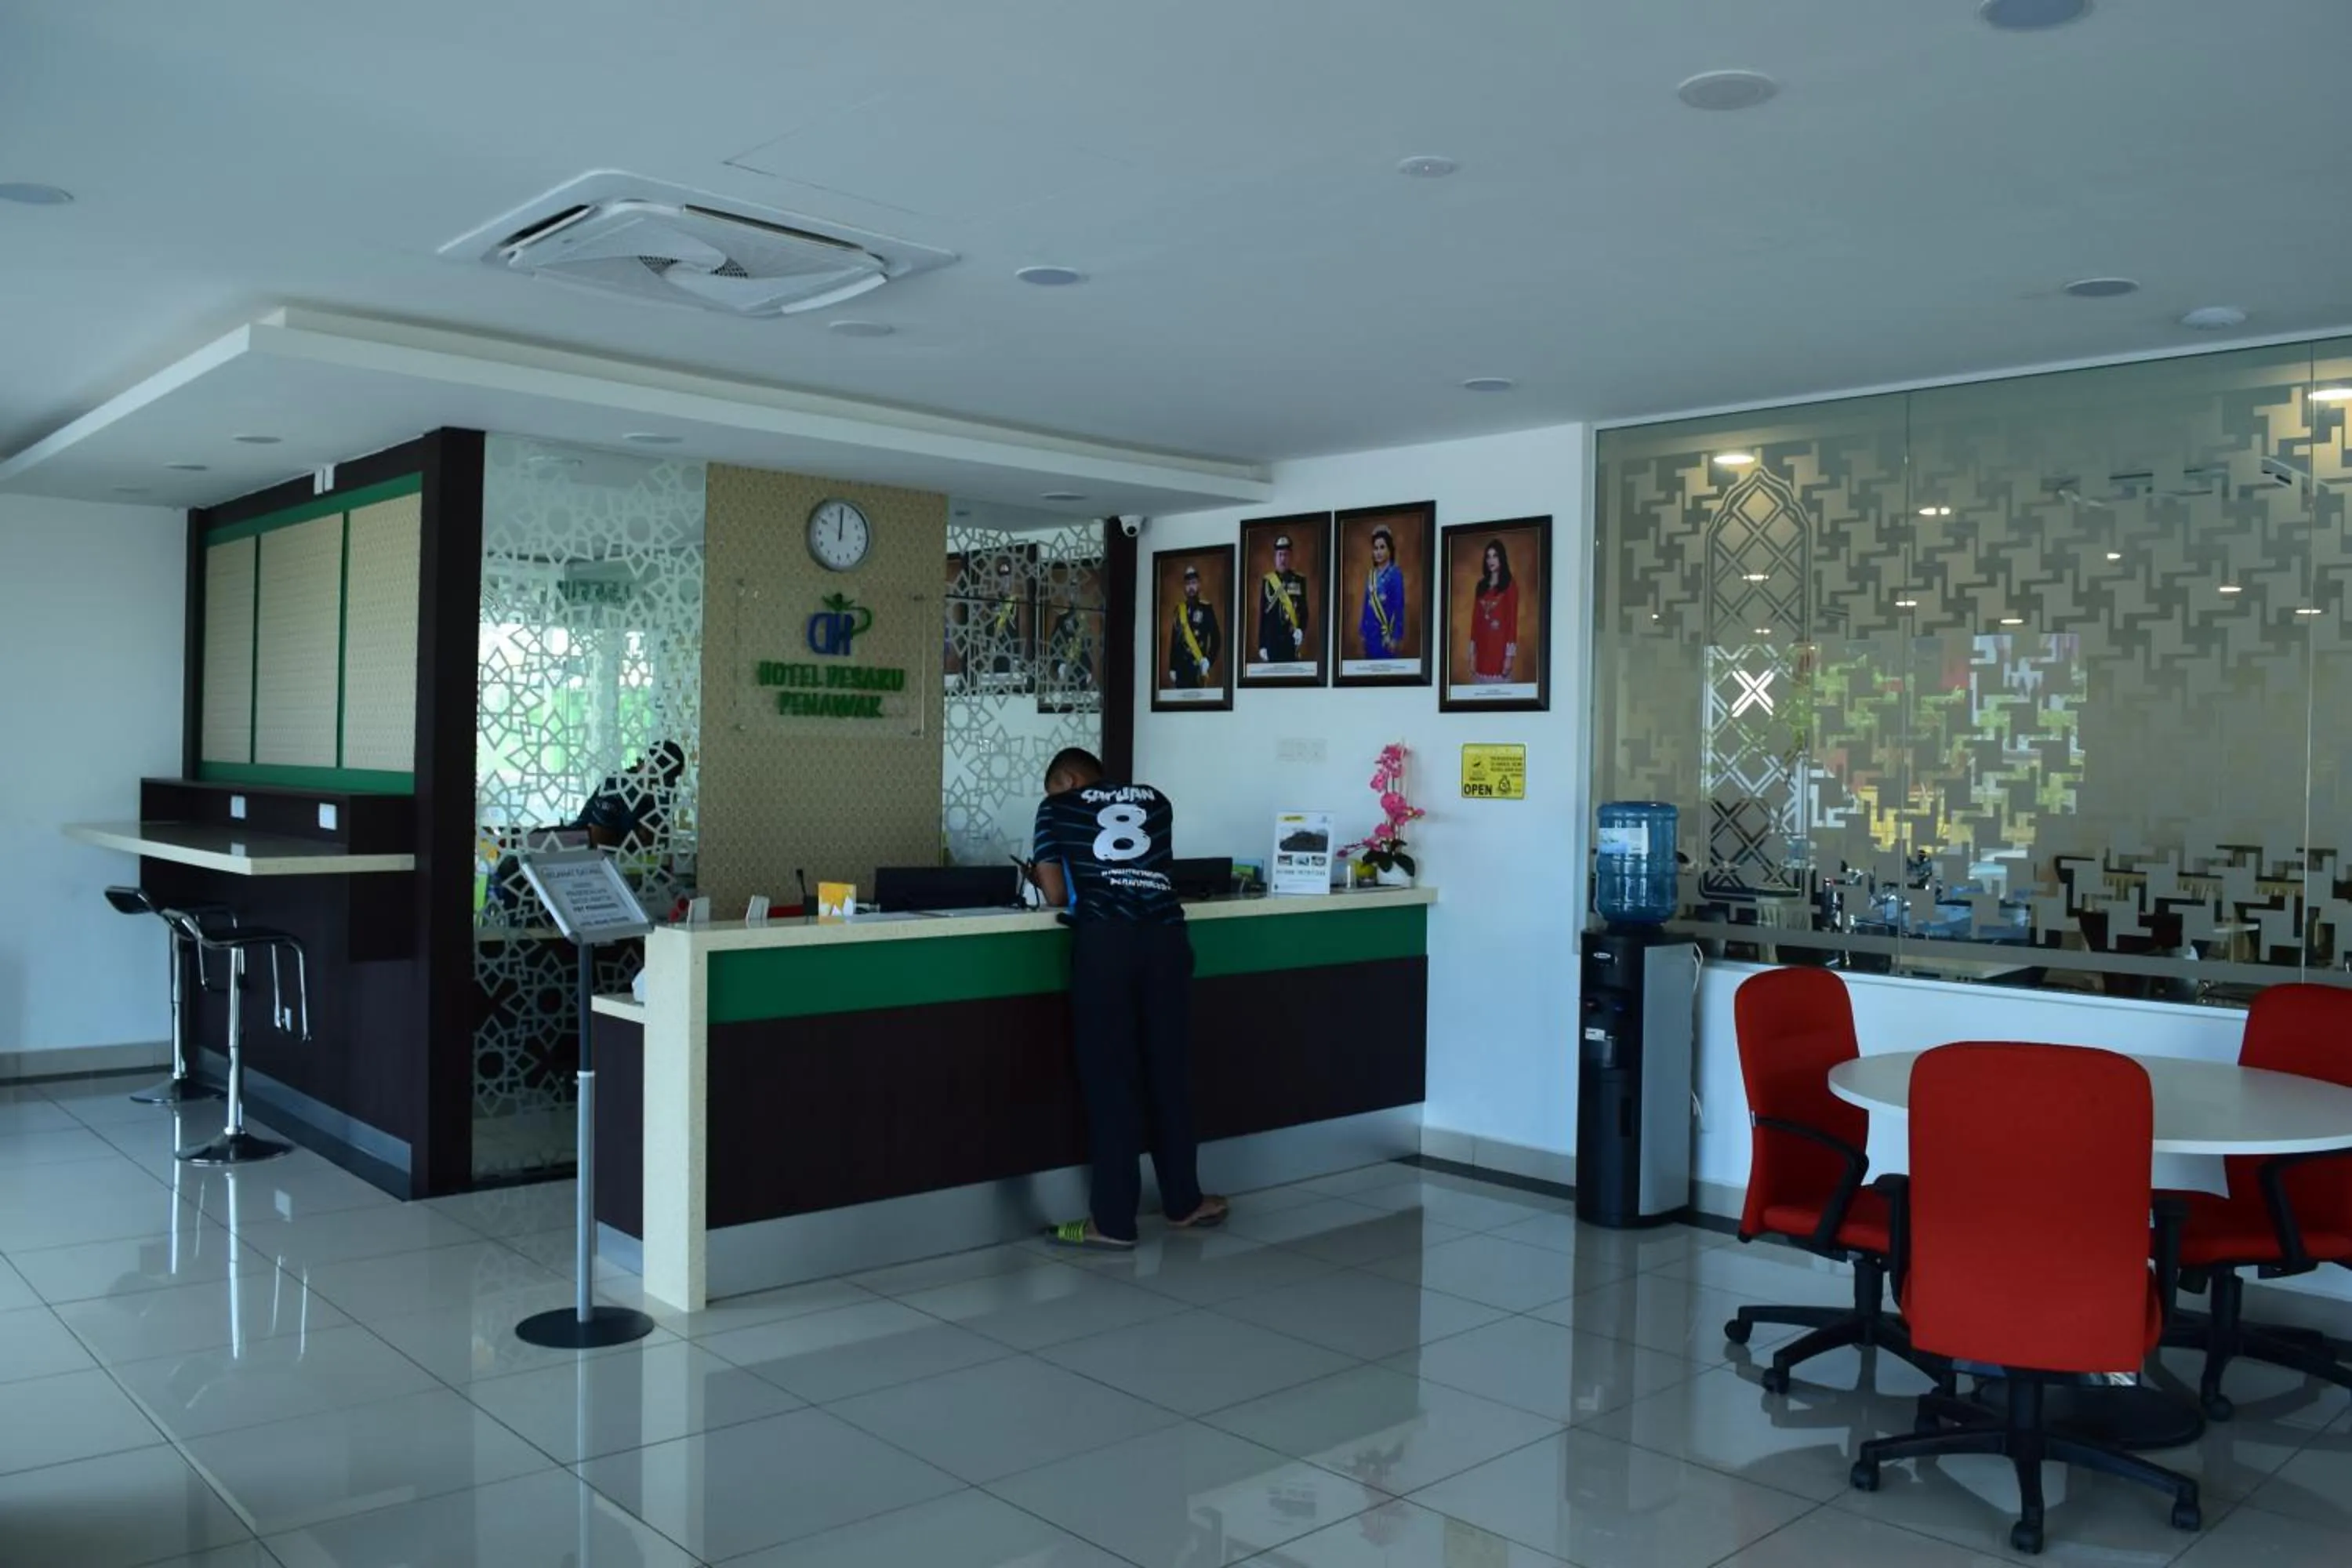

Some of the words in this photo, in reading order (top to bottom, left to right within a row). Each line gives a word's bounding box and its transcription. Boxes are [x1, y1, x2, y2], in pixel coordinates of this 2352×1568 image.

[758, 662, 822, 688] HOTEL
[1464, 783, 1493, 796] OPEN
[1093, 804, 1152, 862] 8
